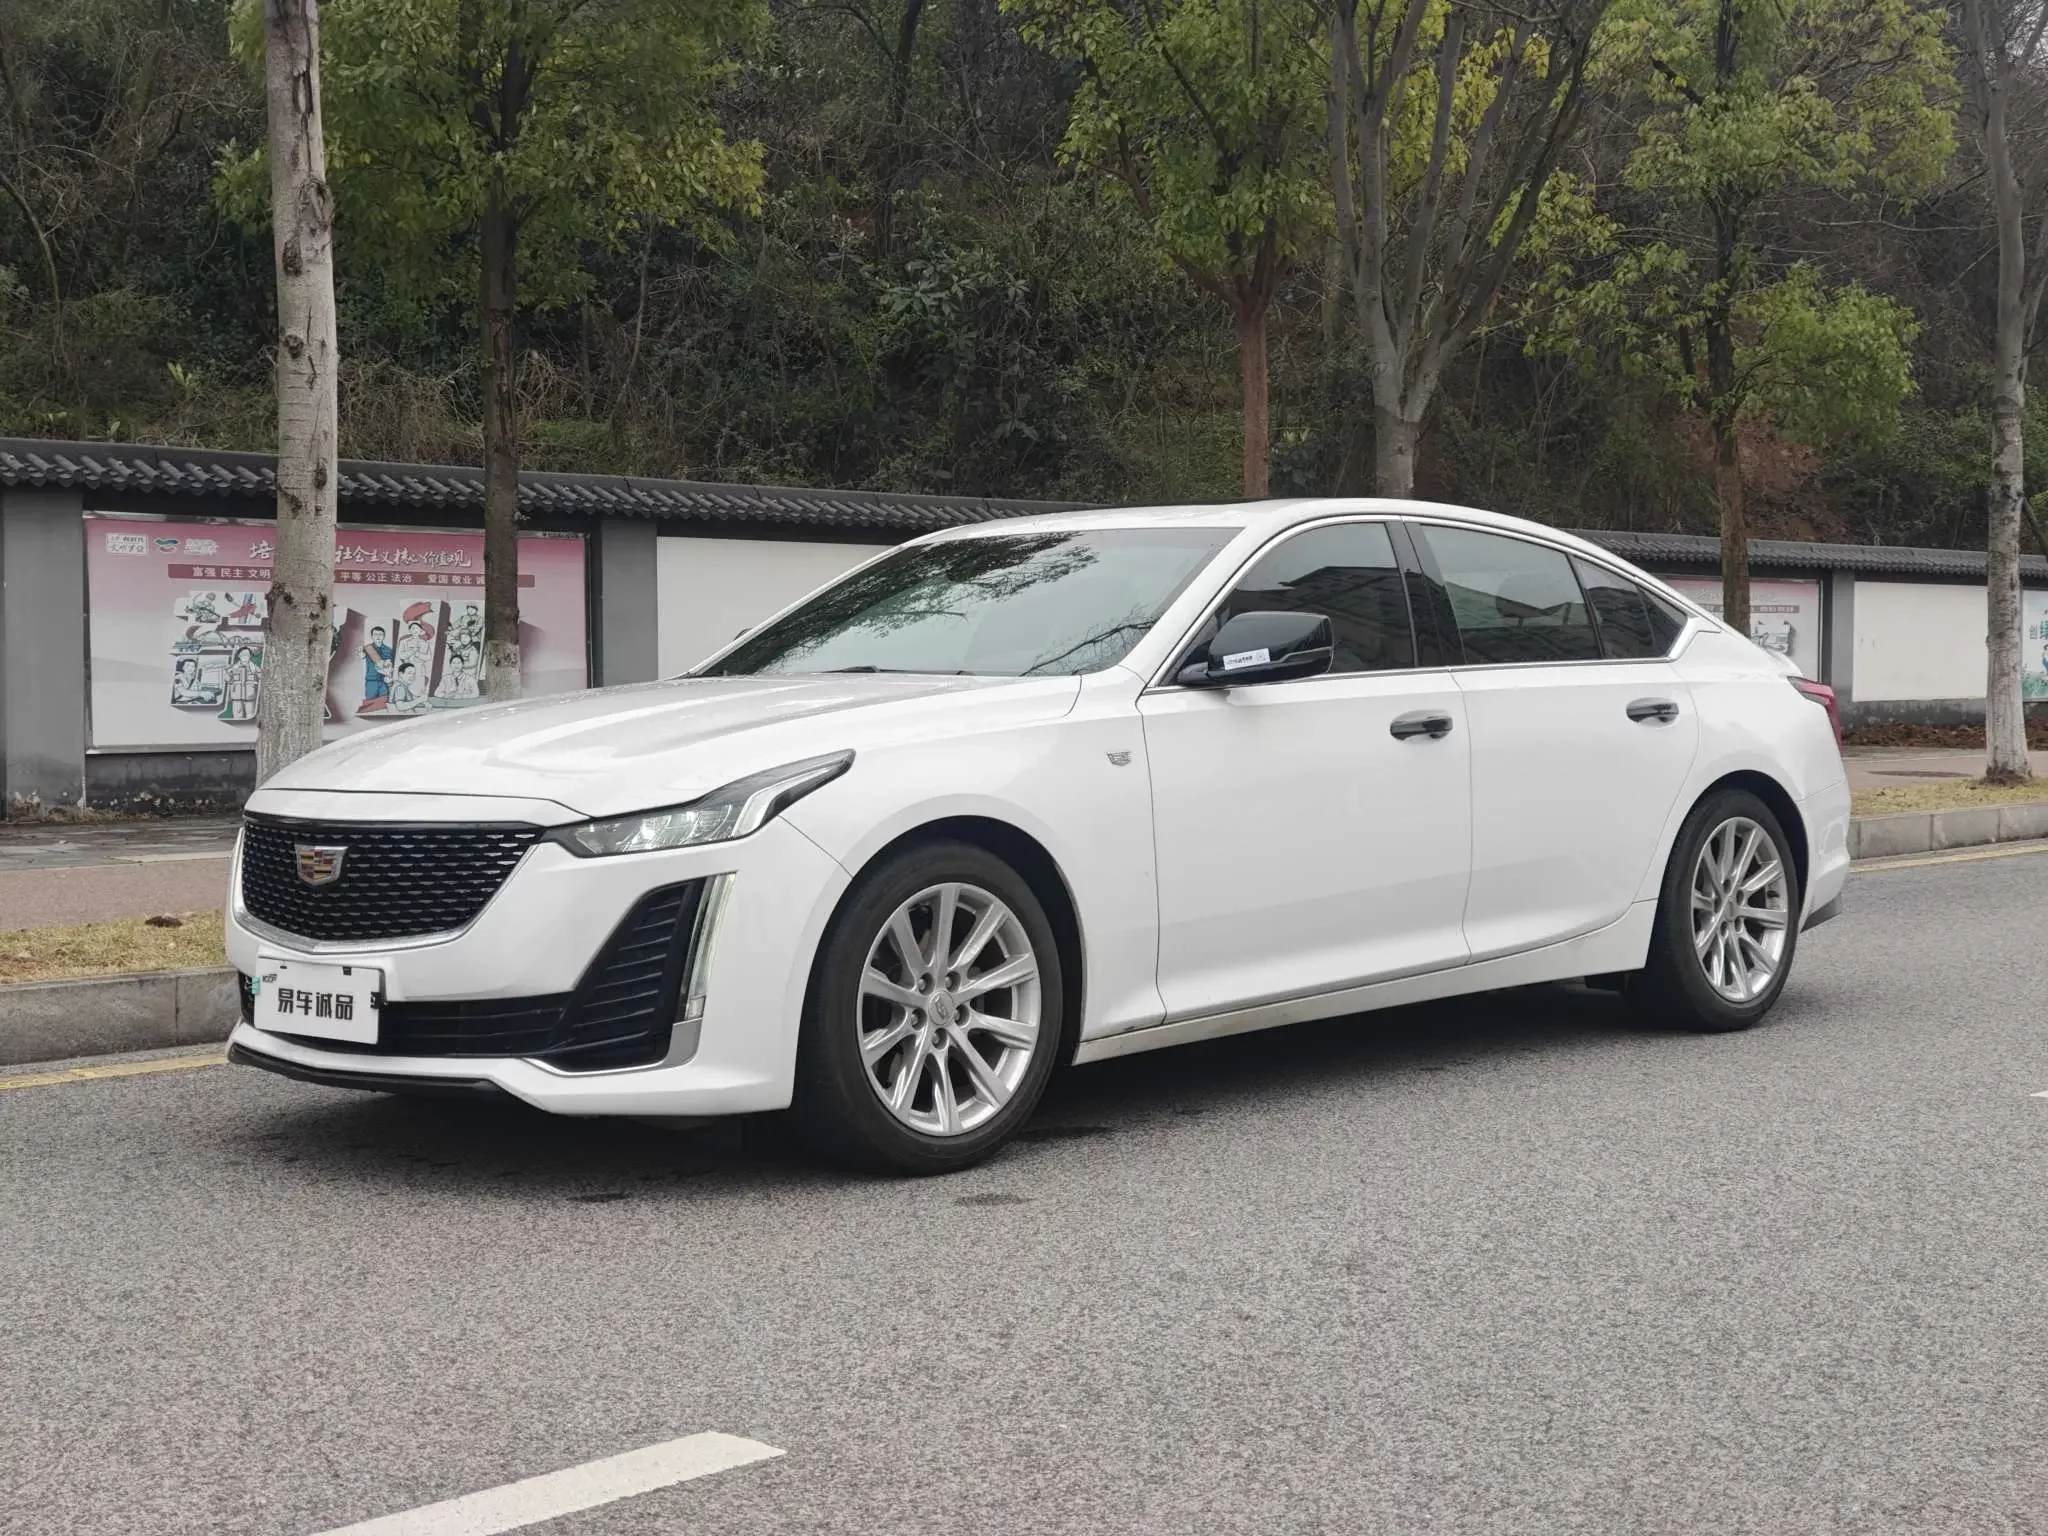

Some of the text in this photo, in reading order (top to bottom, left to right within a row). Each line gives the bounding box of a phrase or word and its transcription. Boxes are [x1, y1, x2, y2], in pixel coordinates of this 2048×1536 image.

[193, 566, 217, 577] 富强
[220, 568, 245, 578] 民主
[248, 568, 272, 579] 文明
[340, 571, 362, 582] 平等
[366, 571, 388, 583] 公正
[391, 572, 412, 583] 法治
[277, 987, 353, 1021] 易车诚品
